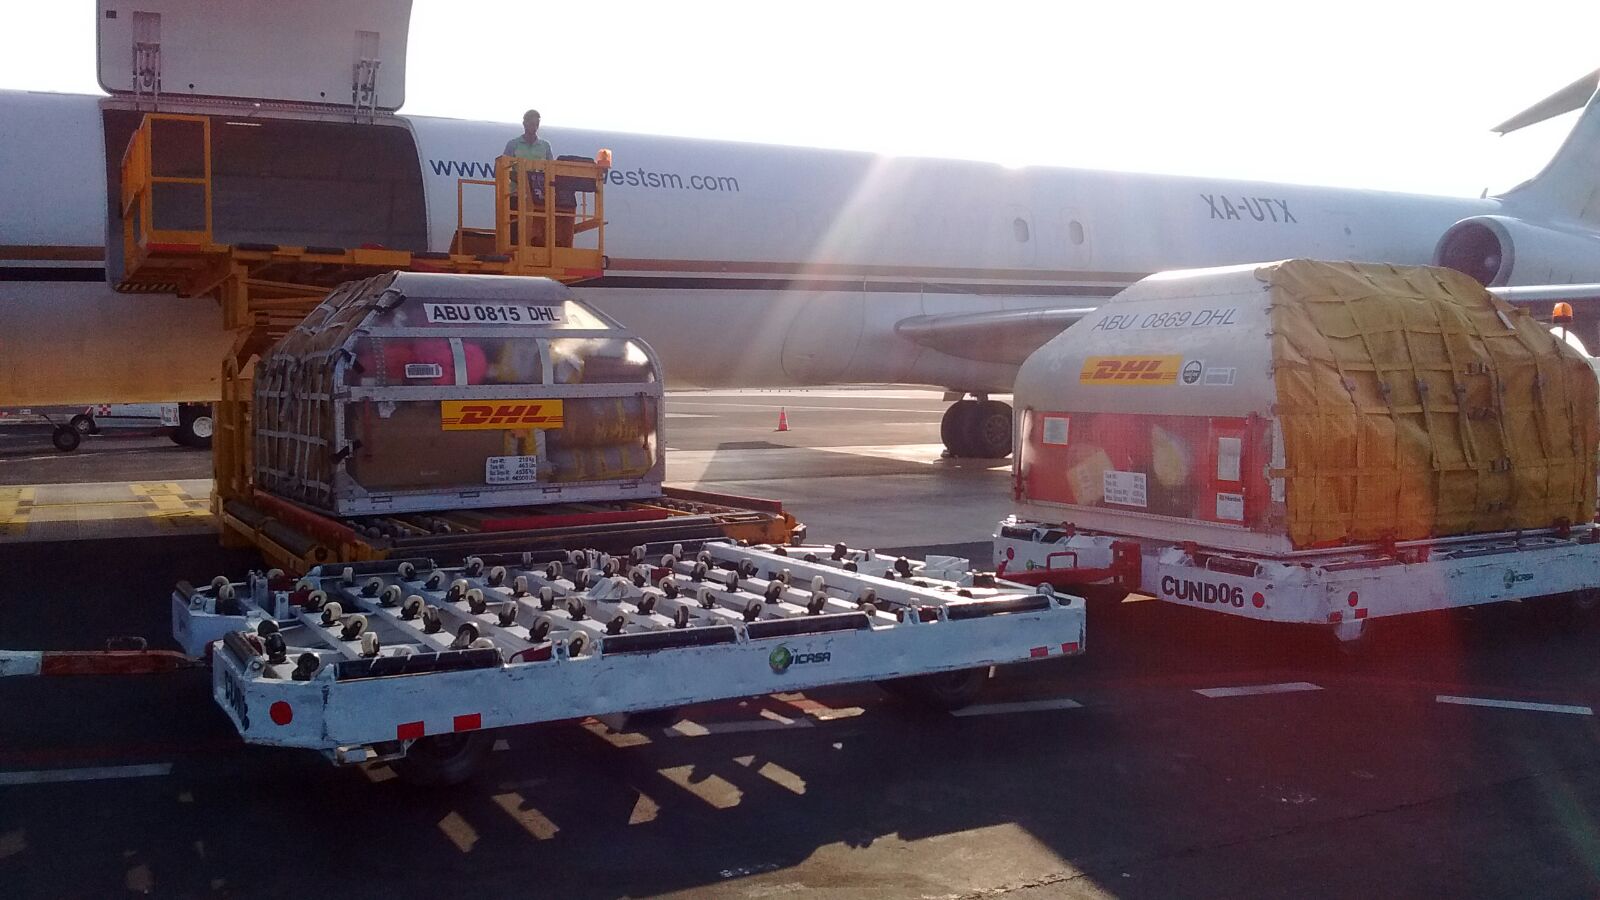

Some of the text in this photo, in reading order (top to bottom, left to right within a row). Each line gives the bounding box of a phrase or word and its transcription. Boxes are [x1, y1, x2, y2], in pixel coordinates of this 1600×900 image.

[1200, 193, 1298, 224] XA-UTX
[433, 304, 560, 323] ABU 0815 DHL
[1091, 307, 1238, 332] ABU 0869 DHL
[1093, 360, 1162, 380] DHL
[460, 405, 547, 424] DHL
[1161, 575, 1245, 608] CUND06
